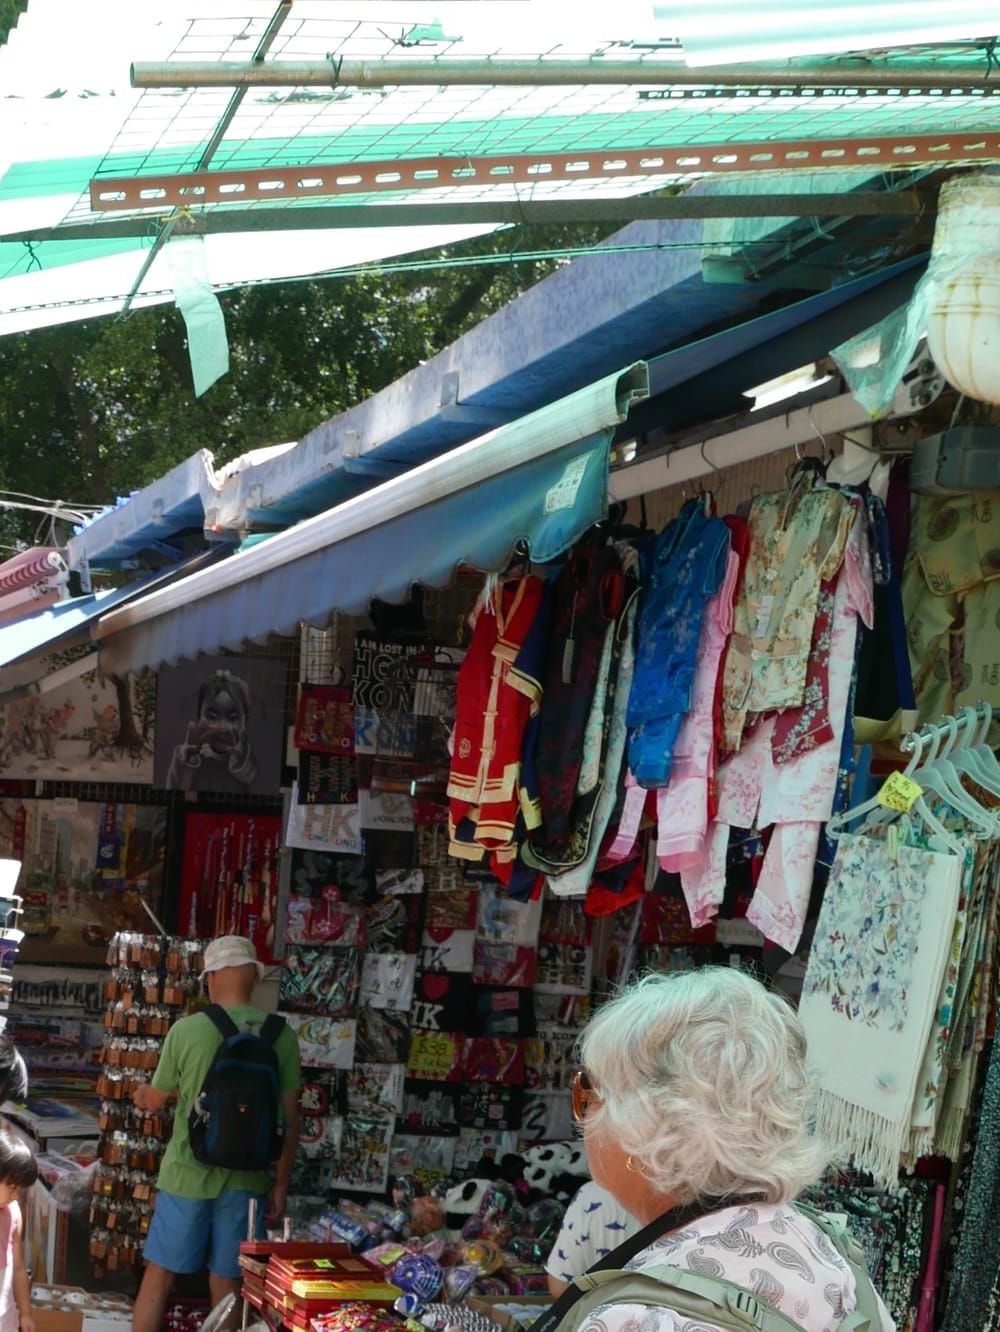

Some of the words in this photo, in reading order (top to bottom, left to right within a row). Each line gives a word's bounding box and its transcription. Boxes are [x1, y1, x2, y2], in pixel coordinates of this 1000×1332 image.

[354, 638, 358, 647] I
[360, 639, 376, 651] AM
[379, 642, 402, 655] LOST
